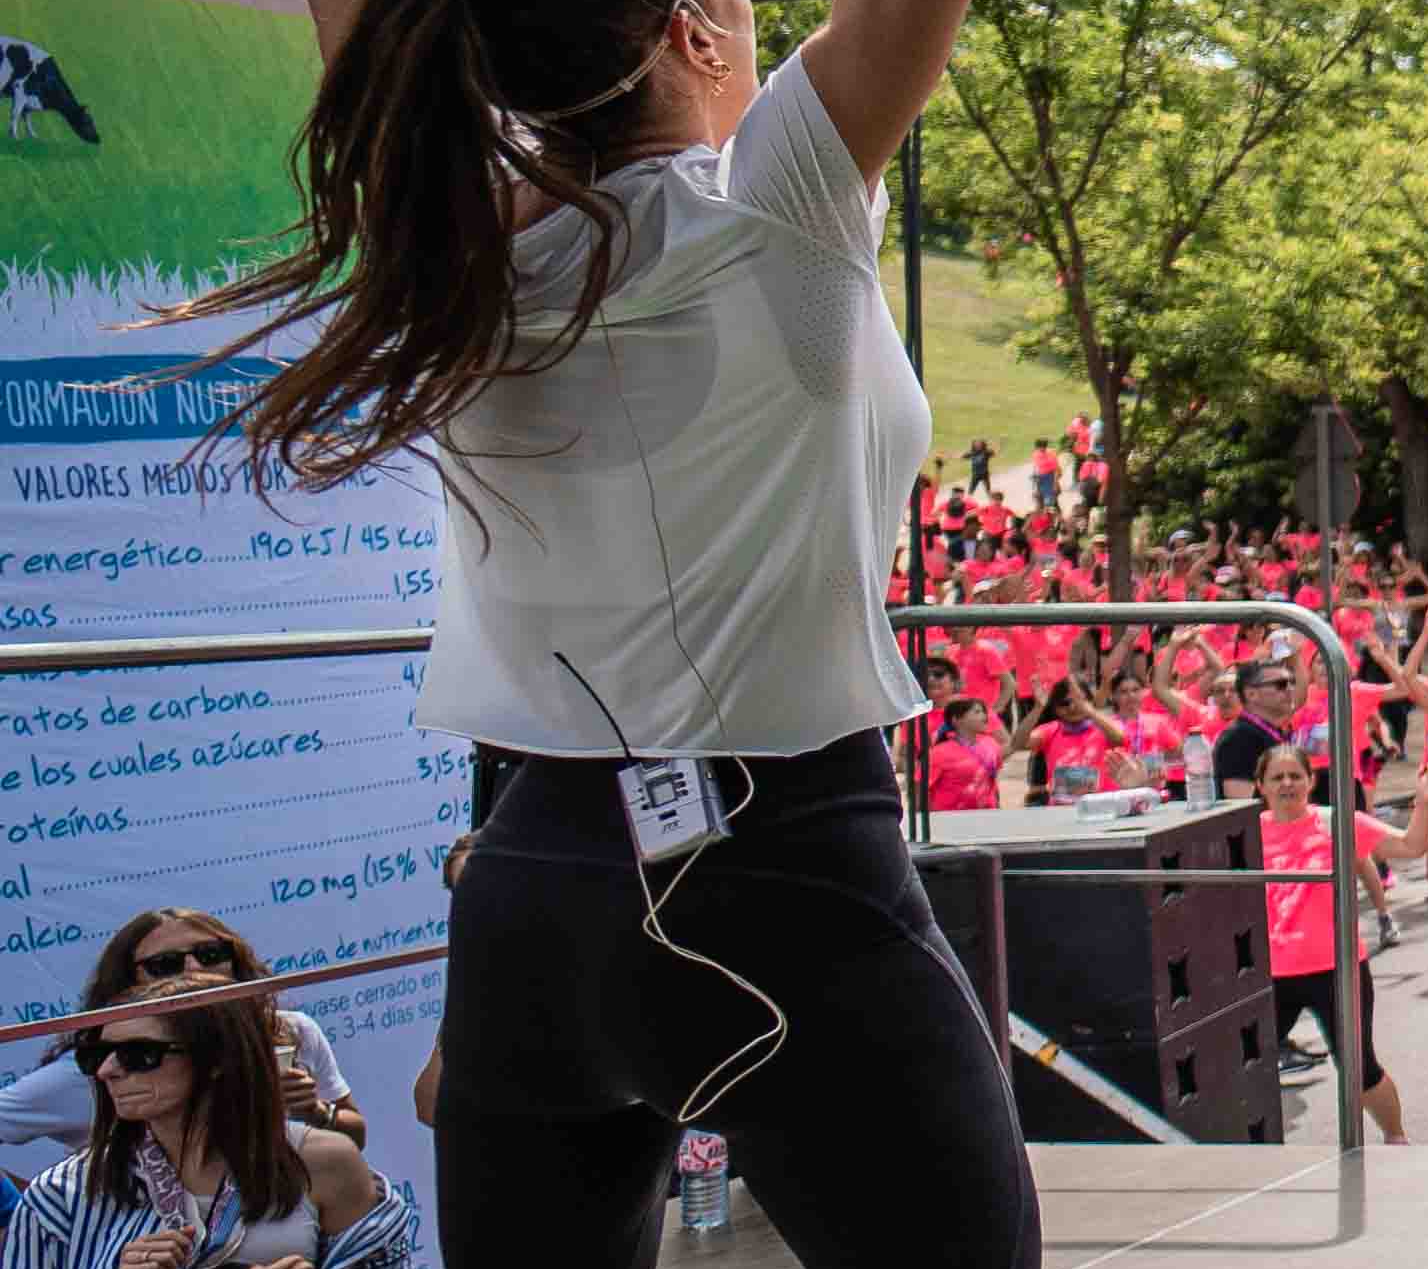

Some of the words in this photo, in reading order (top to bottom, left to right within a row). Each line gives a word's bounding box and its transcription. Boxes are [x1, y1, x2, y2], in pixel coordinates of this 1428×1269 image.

[13, 464, 130, 502] VALORES
[144, 462, 232, 496] MEDIOS
[23, 540, 203, 580] energético
[250, 532, 293, 561] 190
[360, 526, 391, 552] 45
[393, 569, 434, 602] 1,55
[100, 695, 136, 726] de
[148, 685, 271, 722] carbono
[31, 754, 77, 788] los
[88, 742, 182, 780] cuales
[192, 730, 323, 767] azúcares
[271, 875, 315, 904] 120
[322, 871, 357, 899] mg
[363, 848, 417, 890] (15%
[336, 921, 357, 959] de
[361, 916, 449, 952] nutriente
[355, 973, 417, 1006] cerrado
[421, 969, 441, 988] en
[343, 1010, 375, 1039] 3-4
